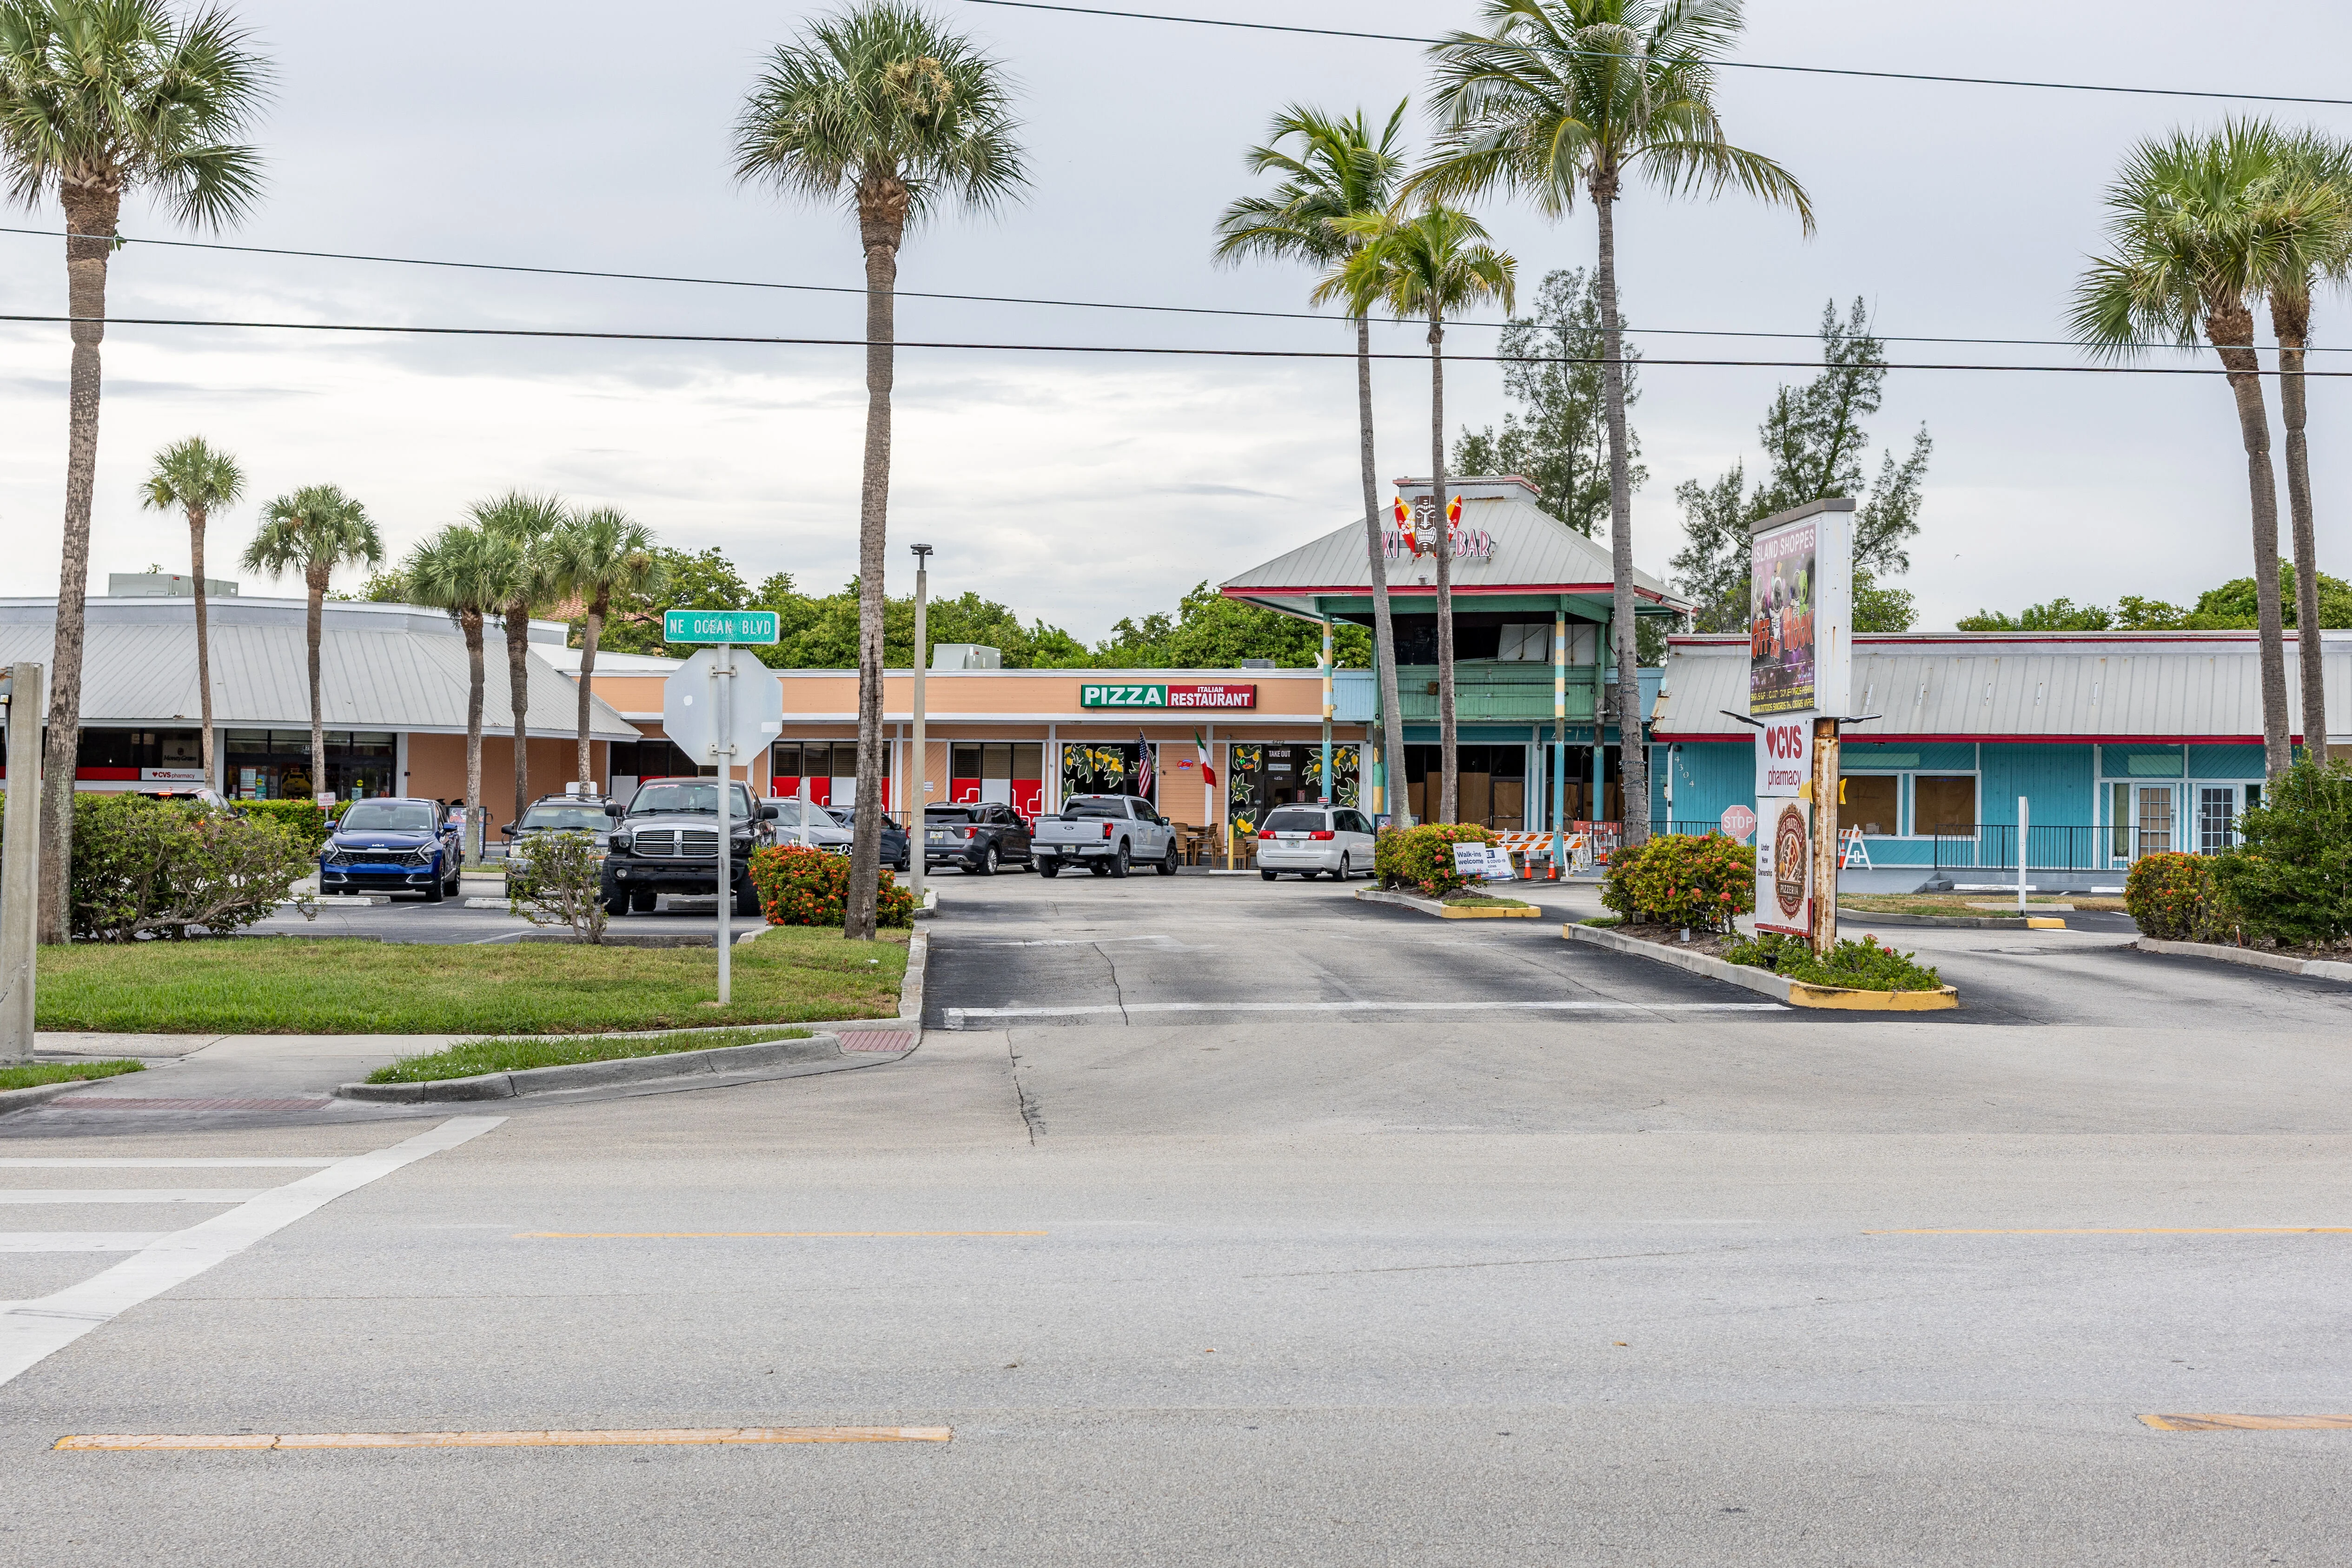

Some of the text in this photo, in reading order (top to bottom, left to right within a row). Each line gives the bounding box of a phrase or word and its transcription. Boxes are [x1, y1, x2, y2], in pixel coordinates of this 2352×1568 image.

[1456, 528, 1492, 557] BAR
[1754, 529, 1814, 564] ISLAND SHOPPES
[670, 619, 771, 635] NE OCEAN BLVD
[1751, 618, 1770, 659] OFF
[1783, 606, 1815, 652] HOOK
[1085, 687, 1162, 704] PIZZA
[1172, 693, 1249, 706] RESTAURANT
[1777, 725, 1802, 759] CVS
[1675, 756, 1695, 787] 4304
[1768, 765, 1802, 791] pharmacy
[1724, 816, 1753, 828] STOP
[1758, 869, 1772, 878] Ownership
[1780, 884, 1799, 895] PIZZERIA
[1781, 898, 1799, 913] RESTAURANT
